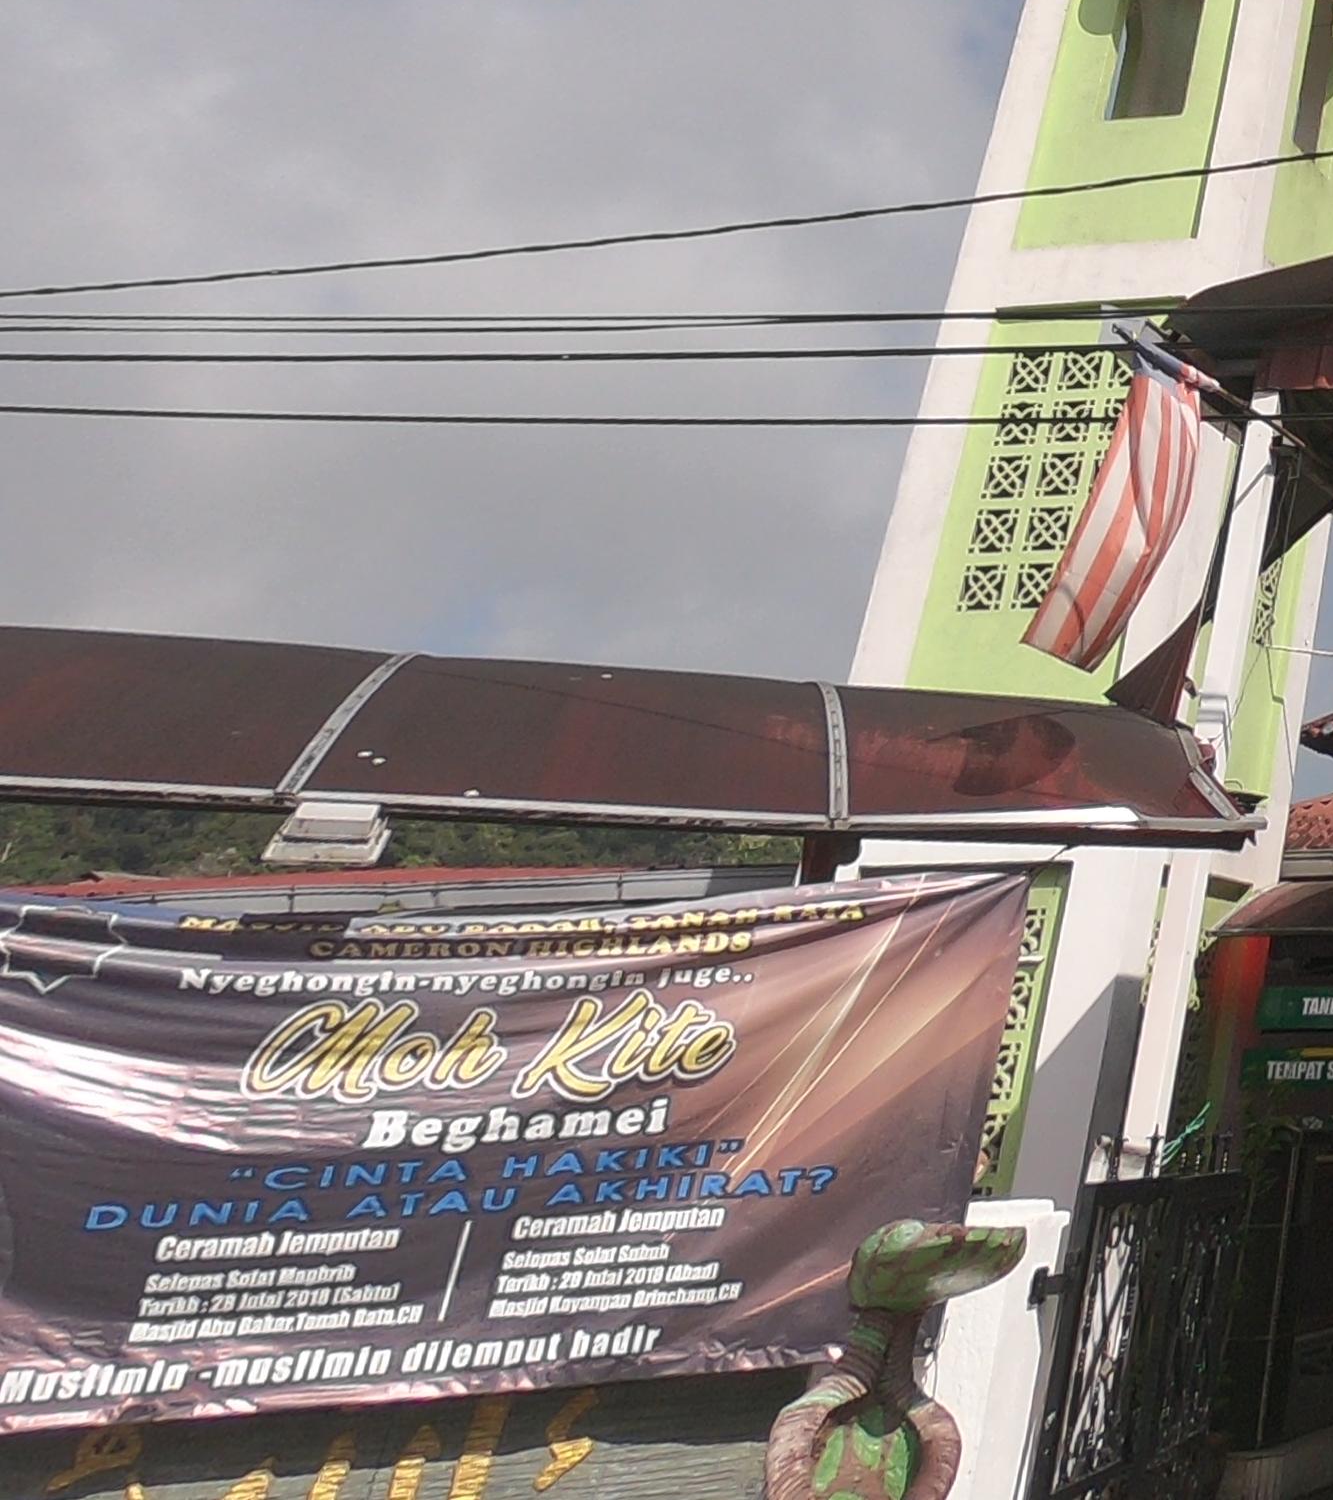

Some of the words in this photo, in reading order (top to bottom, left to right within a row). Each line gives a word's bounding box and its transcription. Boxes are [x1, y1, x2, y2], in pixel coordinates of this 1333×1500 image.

[308, 941, 514, 958] CAMERON
[528, 932, 752, 957] HIGHLANDS
[243, 999, 506, 1099] Moh
[512, 990, 736, 1098] Kite
[1266, 1060, 1326, 1081] TEMPAT
[361, 1098, 669, 1153] Beghamei
[83, 1196, 311, 1232] DUNIA
[345, 1187, 516, 1220] ATAU
[544, 1167, 837, 1206] AKHIRAT?
[155, 1230, 275, 1262] Ceramah
[276, 1227, 401, 1256] Jemputan
[511, 1209, 616, 1240] Ceramah
[617, 1205, 726, 1233] Jemputan
[0, 1362, 189, 1403] Muslimin
[400, 1337, 561, 1383] dijemput
[569, 1323, 662, 1365] hadir
